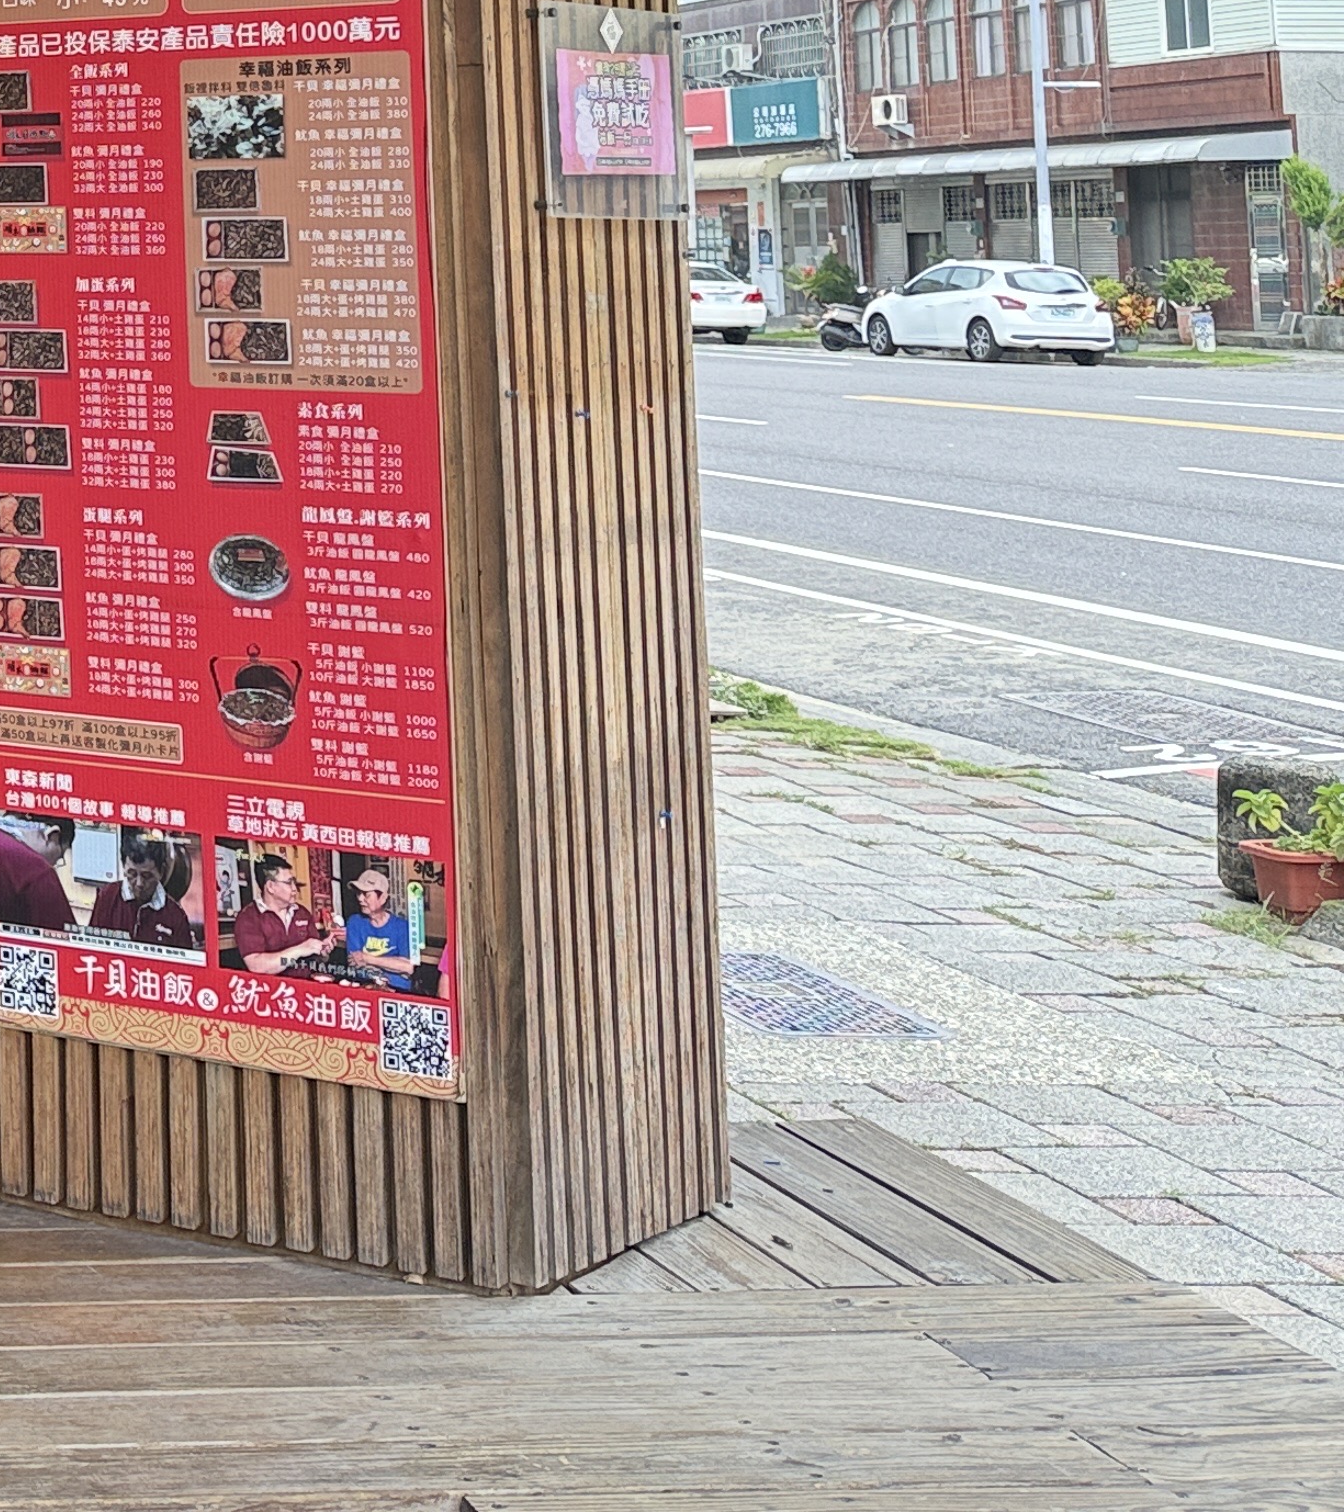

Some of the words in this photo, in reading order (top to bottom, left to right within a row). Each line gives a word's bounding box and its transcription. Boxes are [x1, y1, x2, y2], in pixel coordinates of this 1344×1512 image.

[239, 57, 351, 78] 幸福油飯系列
[298, 402, 364, 420] 素食系列
[404, 667, 434, 678] 1100
[5, 768, 73, 792] 東森新聞
[5, 790, 114, 818] 台灣1001個故事
[121, 804, 185, 826] 報導推薦
[227, 795, 305, 821] 三立電視
[227, 815, 298, 839] 草地狀元
[74, 956, 195, 1009] 干貝油飯
[223, 975, 374, 1034] 魷魚油飯
